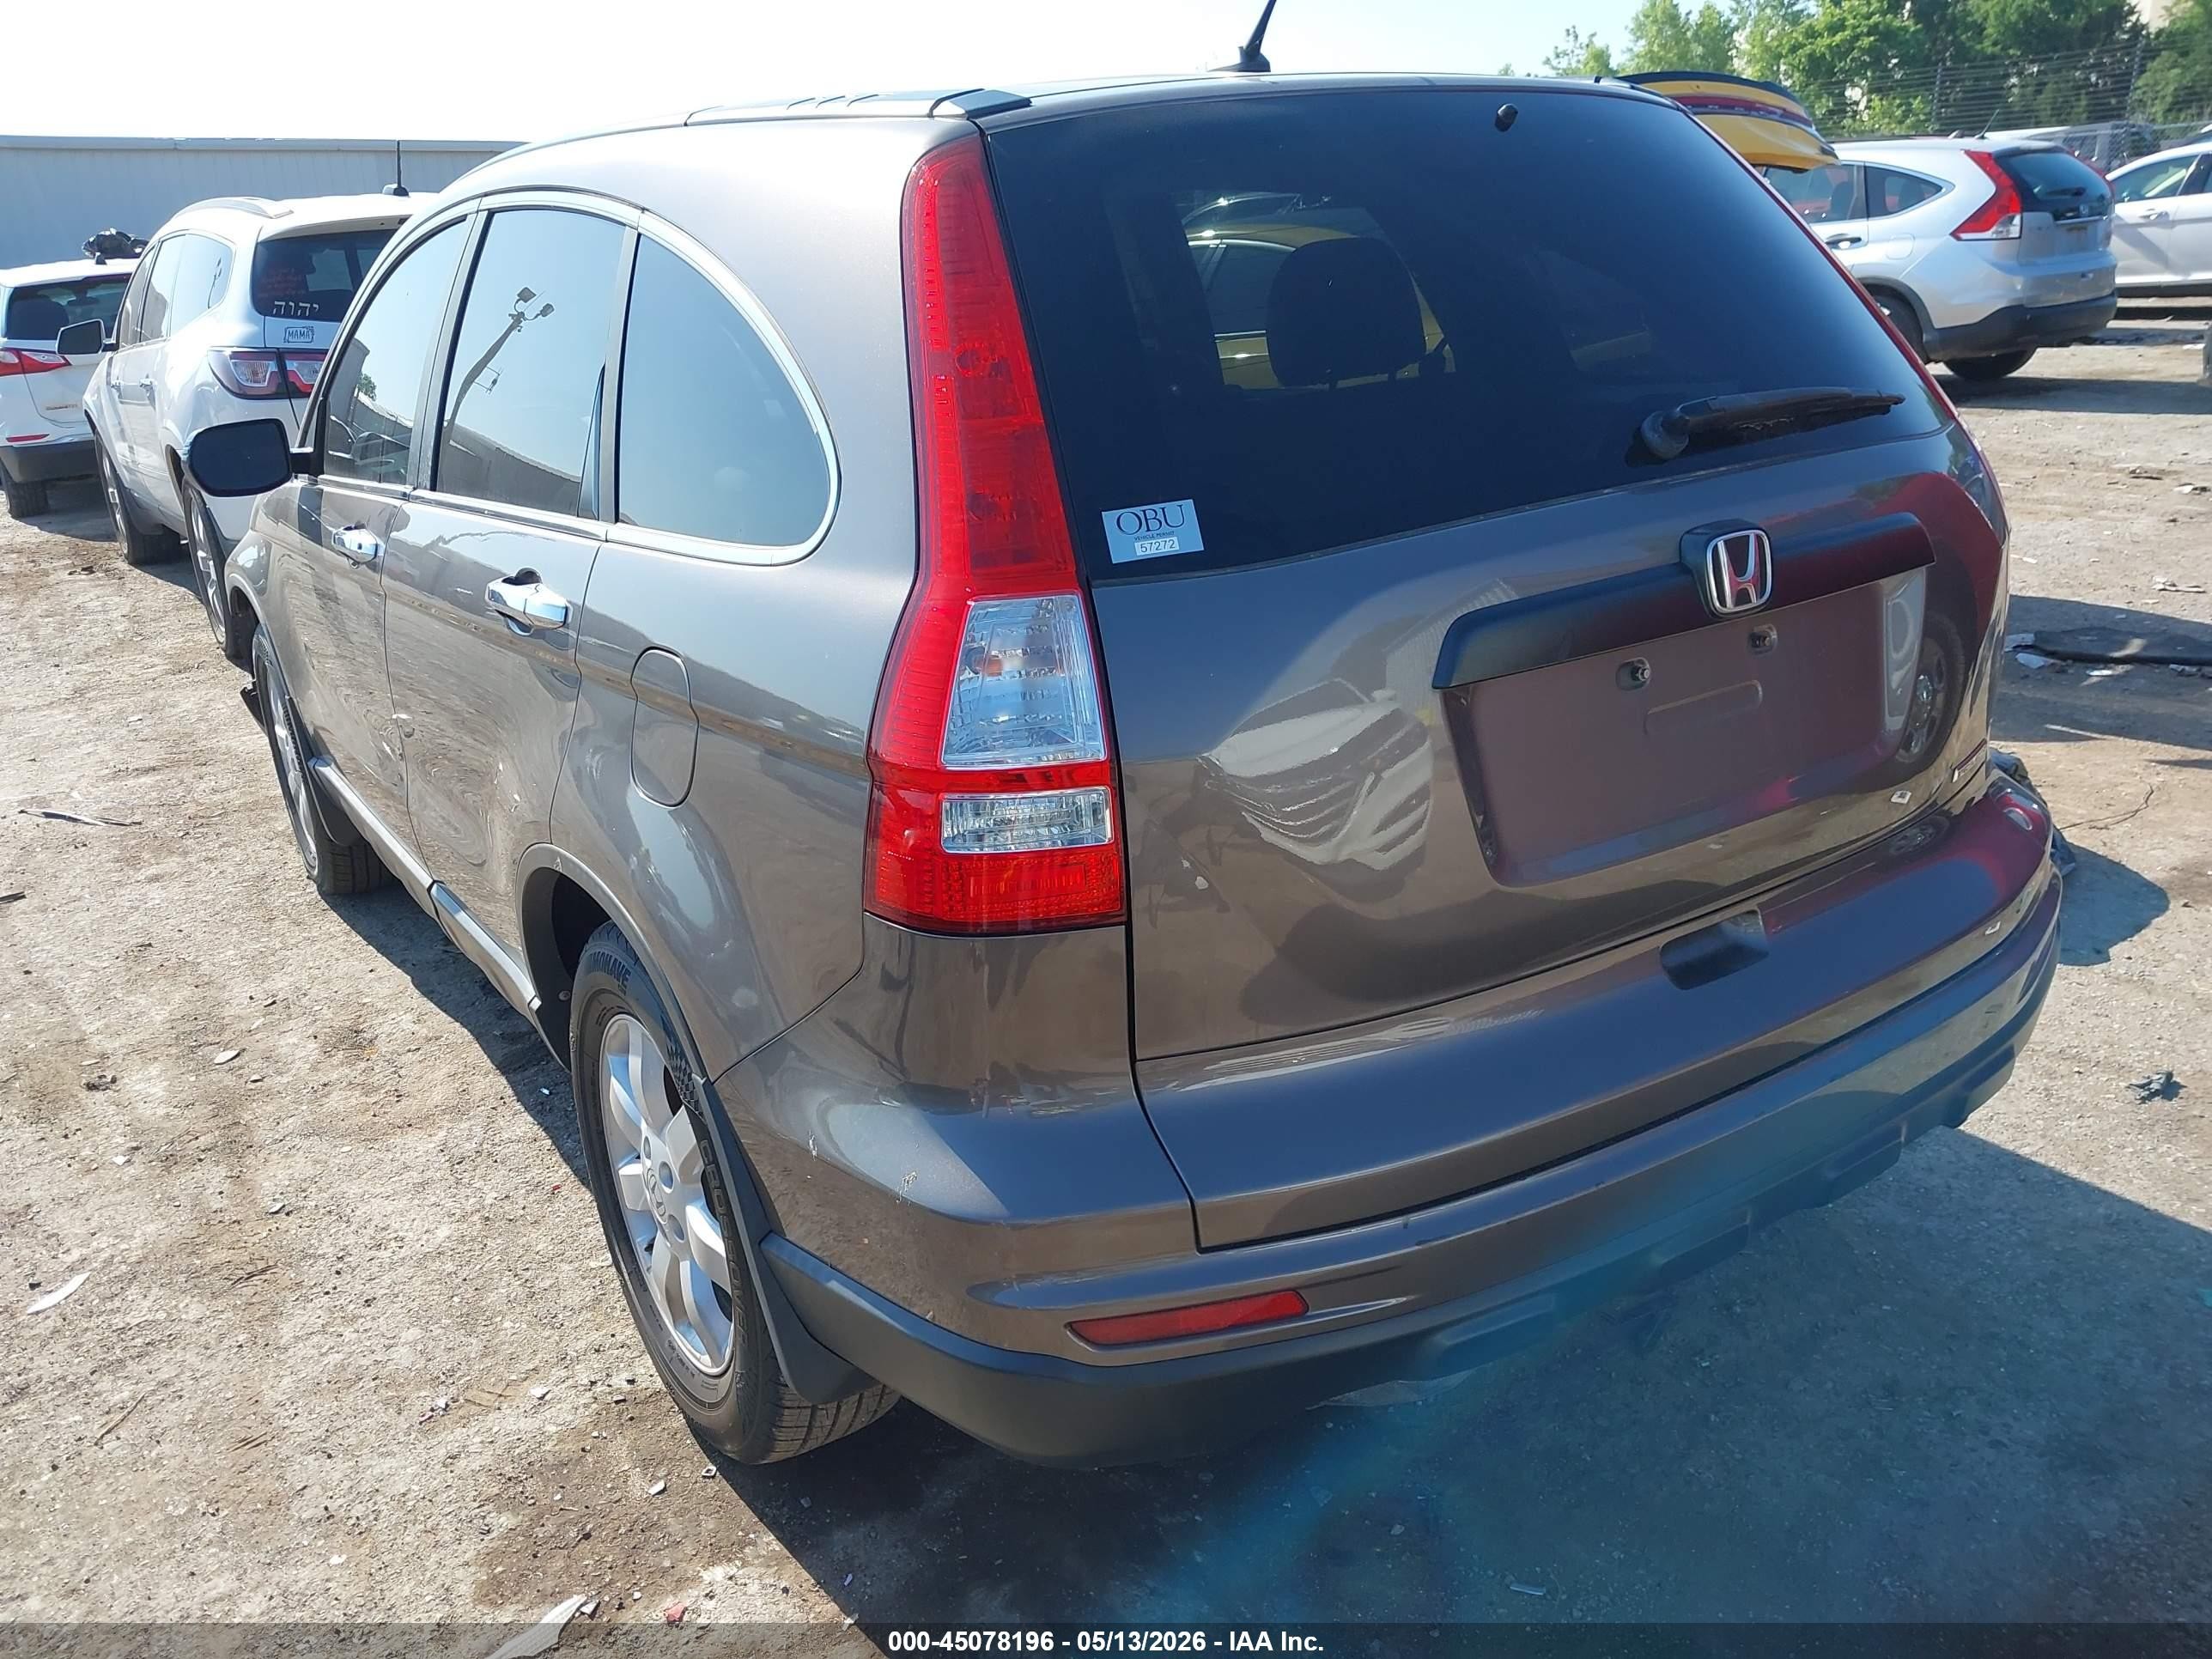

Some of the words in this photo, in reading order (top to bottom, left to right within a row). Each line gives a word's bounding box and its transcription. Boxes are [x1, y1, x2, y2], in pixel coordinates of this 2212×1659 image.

[288, 330, 311, 340] MAMA
[1116, 504, 1185, 535] OBU
[1139, 538, 1176, 553] 57272
